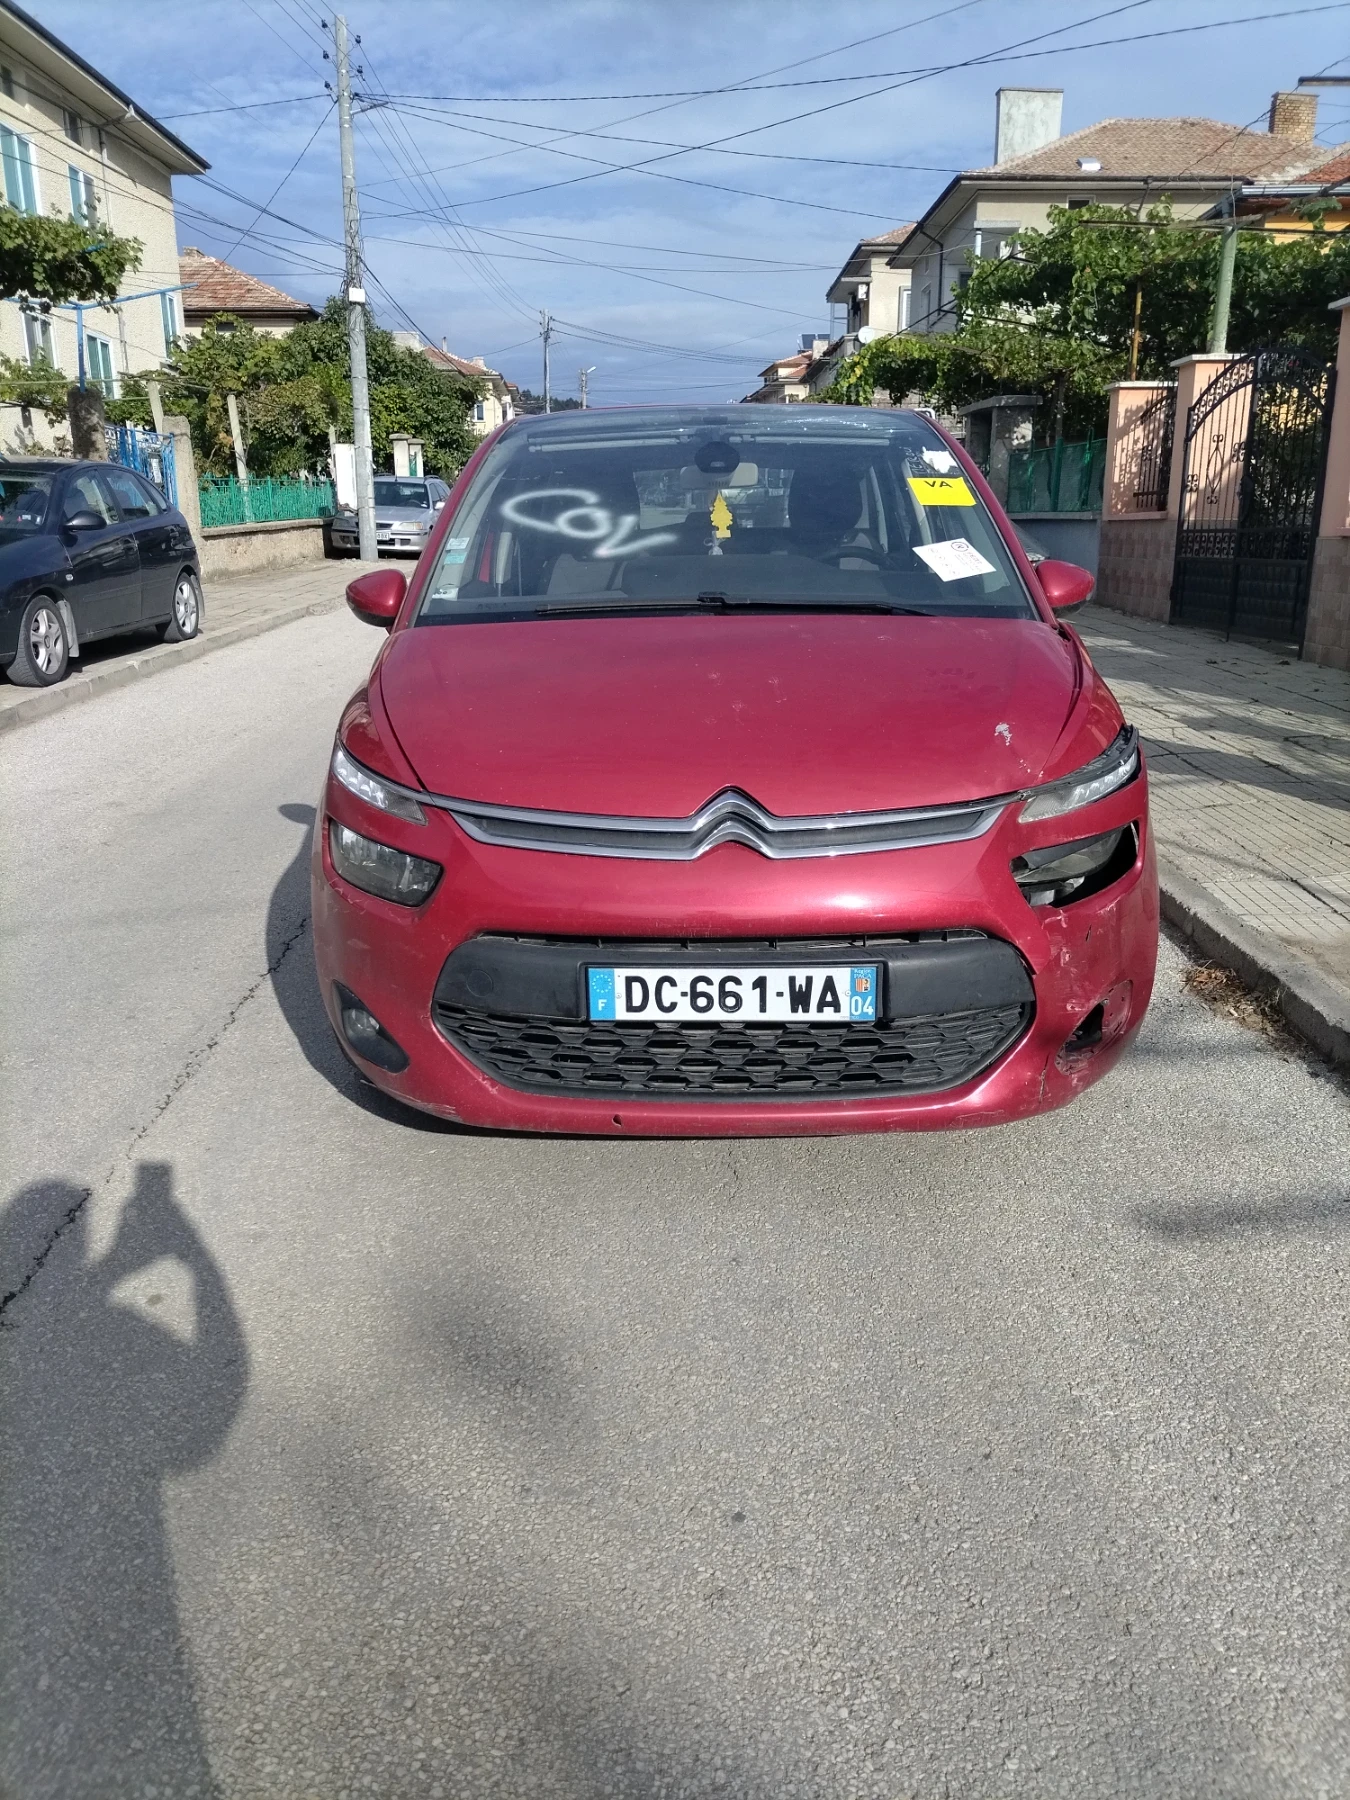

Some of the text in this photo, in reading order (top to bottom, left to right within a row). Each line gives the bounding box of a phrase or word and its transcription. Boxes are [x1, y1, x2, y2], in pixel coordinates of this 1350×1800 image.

[923, 480, 953, 488] VA
[625, 975, 841, 1013] DC-661-WA
[597, 999, 608, 1011] F
[851, 995, 874, 1016] 04
